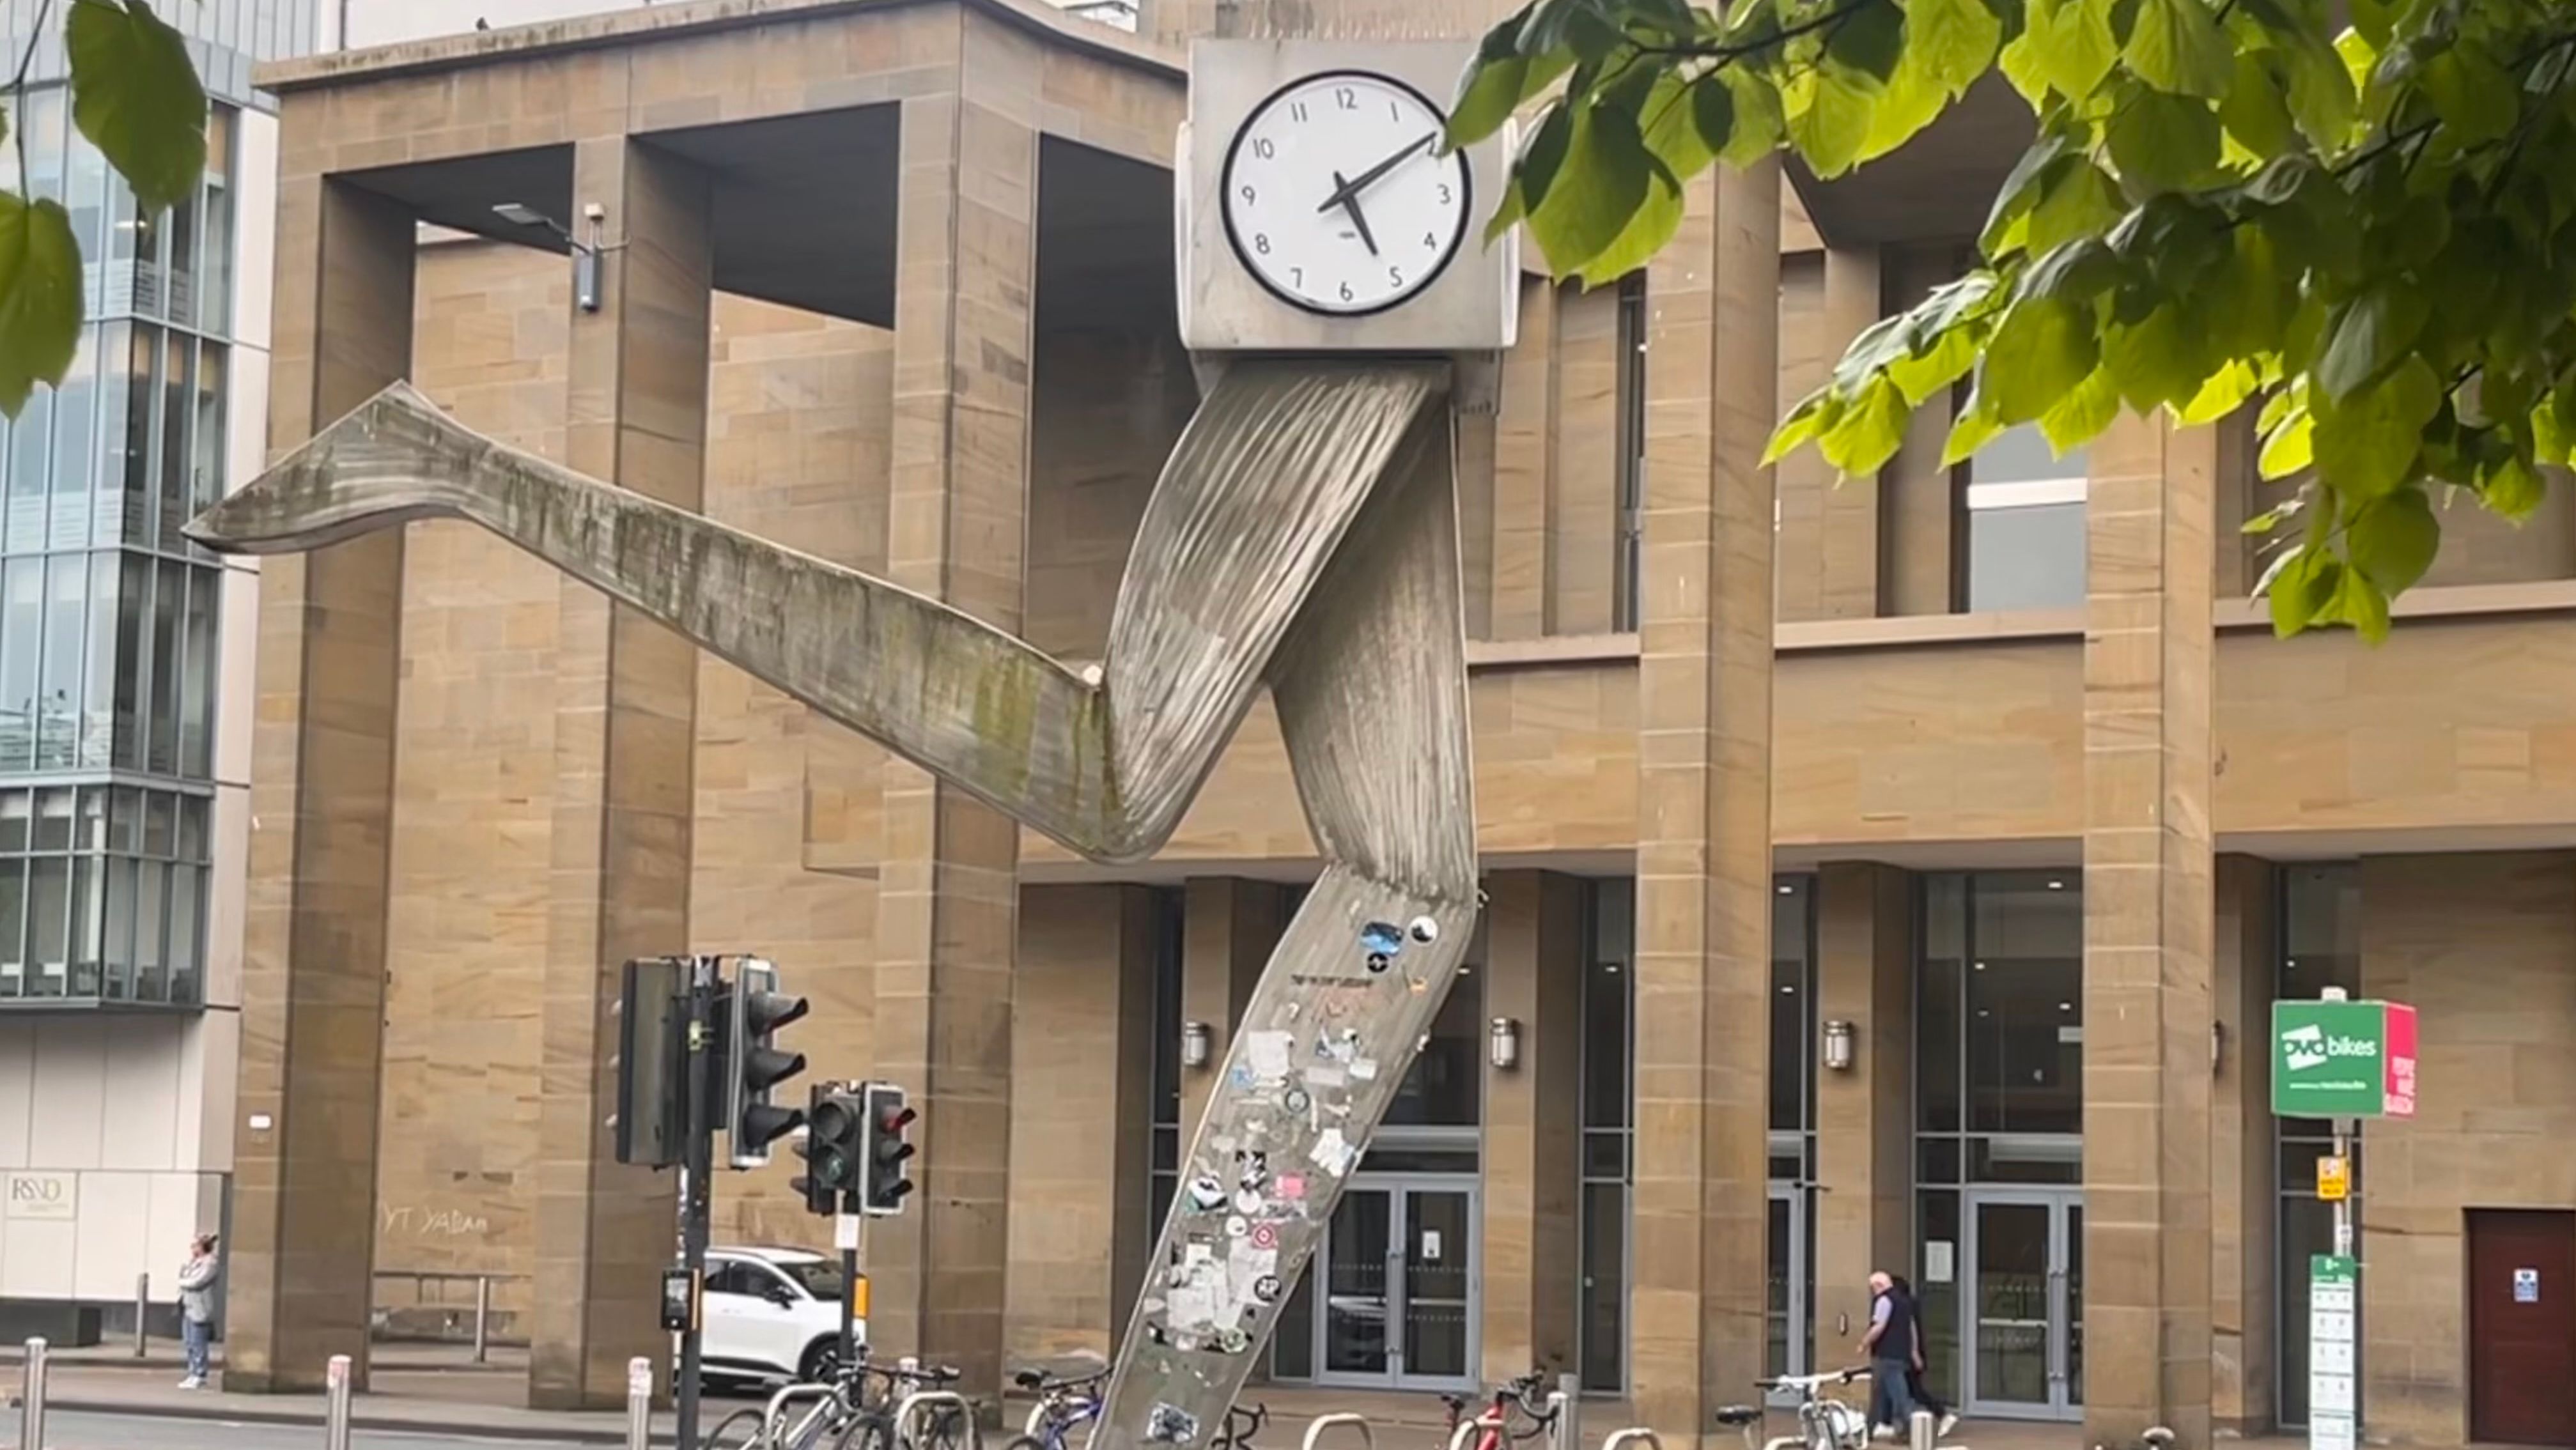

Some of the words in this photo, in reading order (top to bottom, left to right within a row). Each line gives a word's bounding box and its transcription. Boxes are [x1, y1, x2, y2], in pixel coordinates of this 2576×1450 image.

[1336, 88, 1357, 110] 12
[1290, 102, 1308, 123] 11
[1390, 102, 1399, 122] 1
[1252, 137, 1275, 160] 10
[1241, 185, 1256, 206] 9
[1438, 184, 1452, 205] 3
[1254, 233, 1271, 255] 8
[1423, 231, 1437, 251] 4
[1289, 267, 1303, 289] 7
[1388, 266, 1403, 288] 5
[1338, 281, 1354, 302] 6
[2327, 1035, 2377, 1056] bikes
